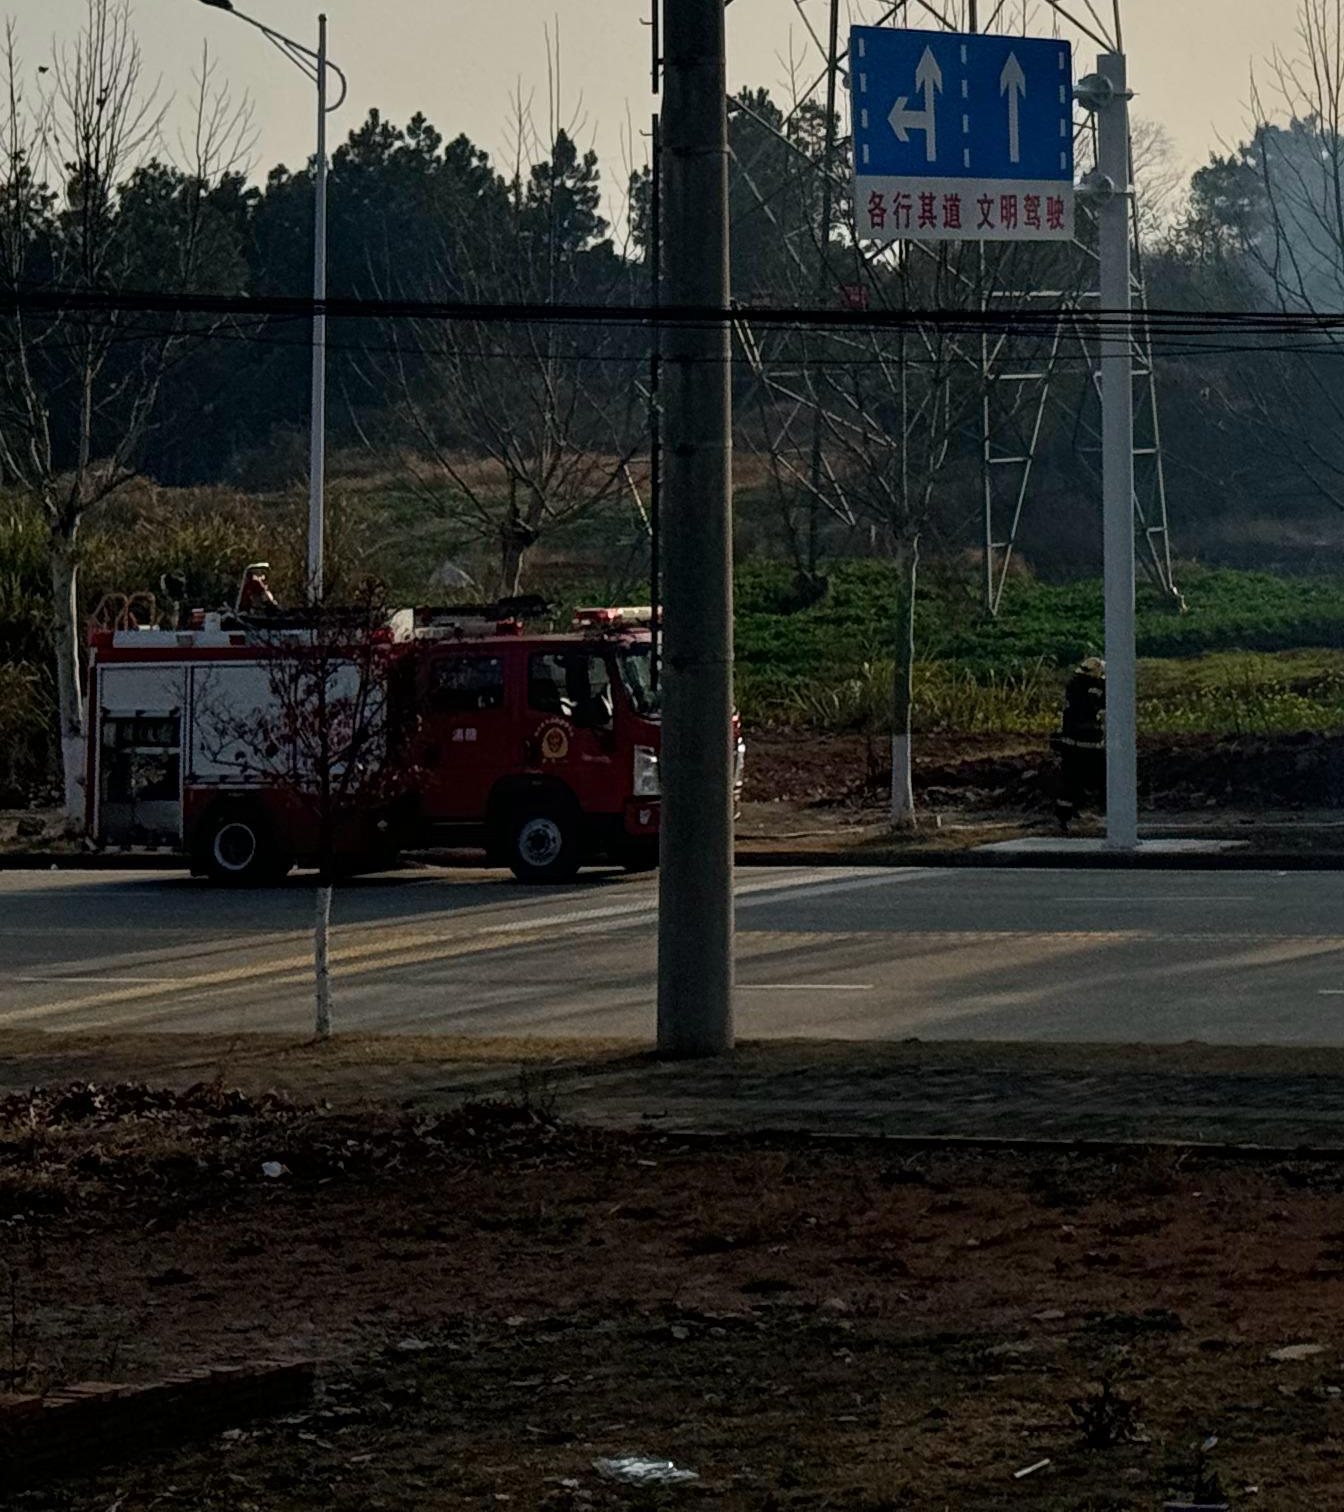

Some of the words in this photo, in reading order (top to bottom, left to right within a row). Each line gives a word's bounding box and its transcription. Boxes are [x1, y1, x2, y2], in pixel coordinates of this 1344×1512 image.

[868, 190, 961, 230] 各行其道
[976, 193, 1065, 231] 文明驾驶
